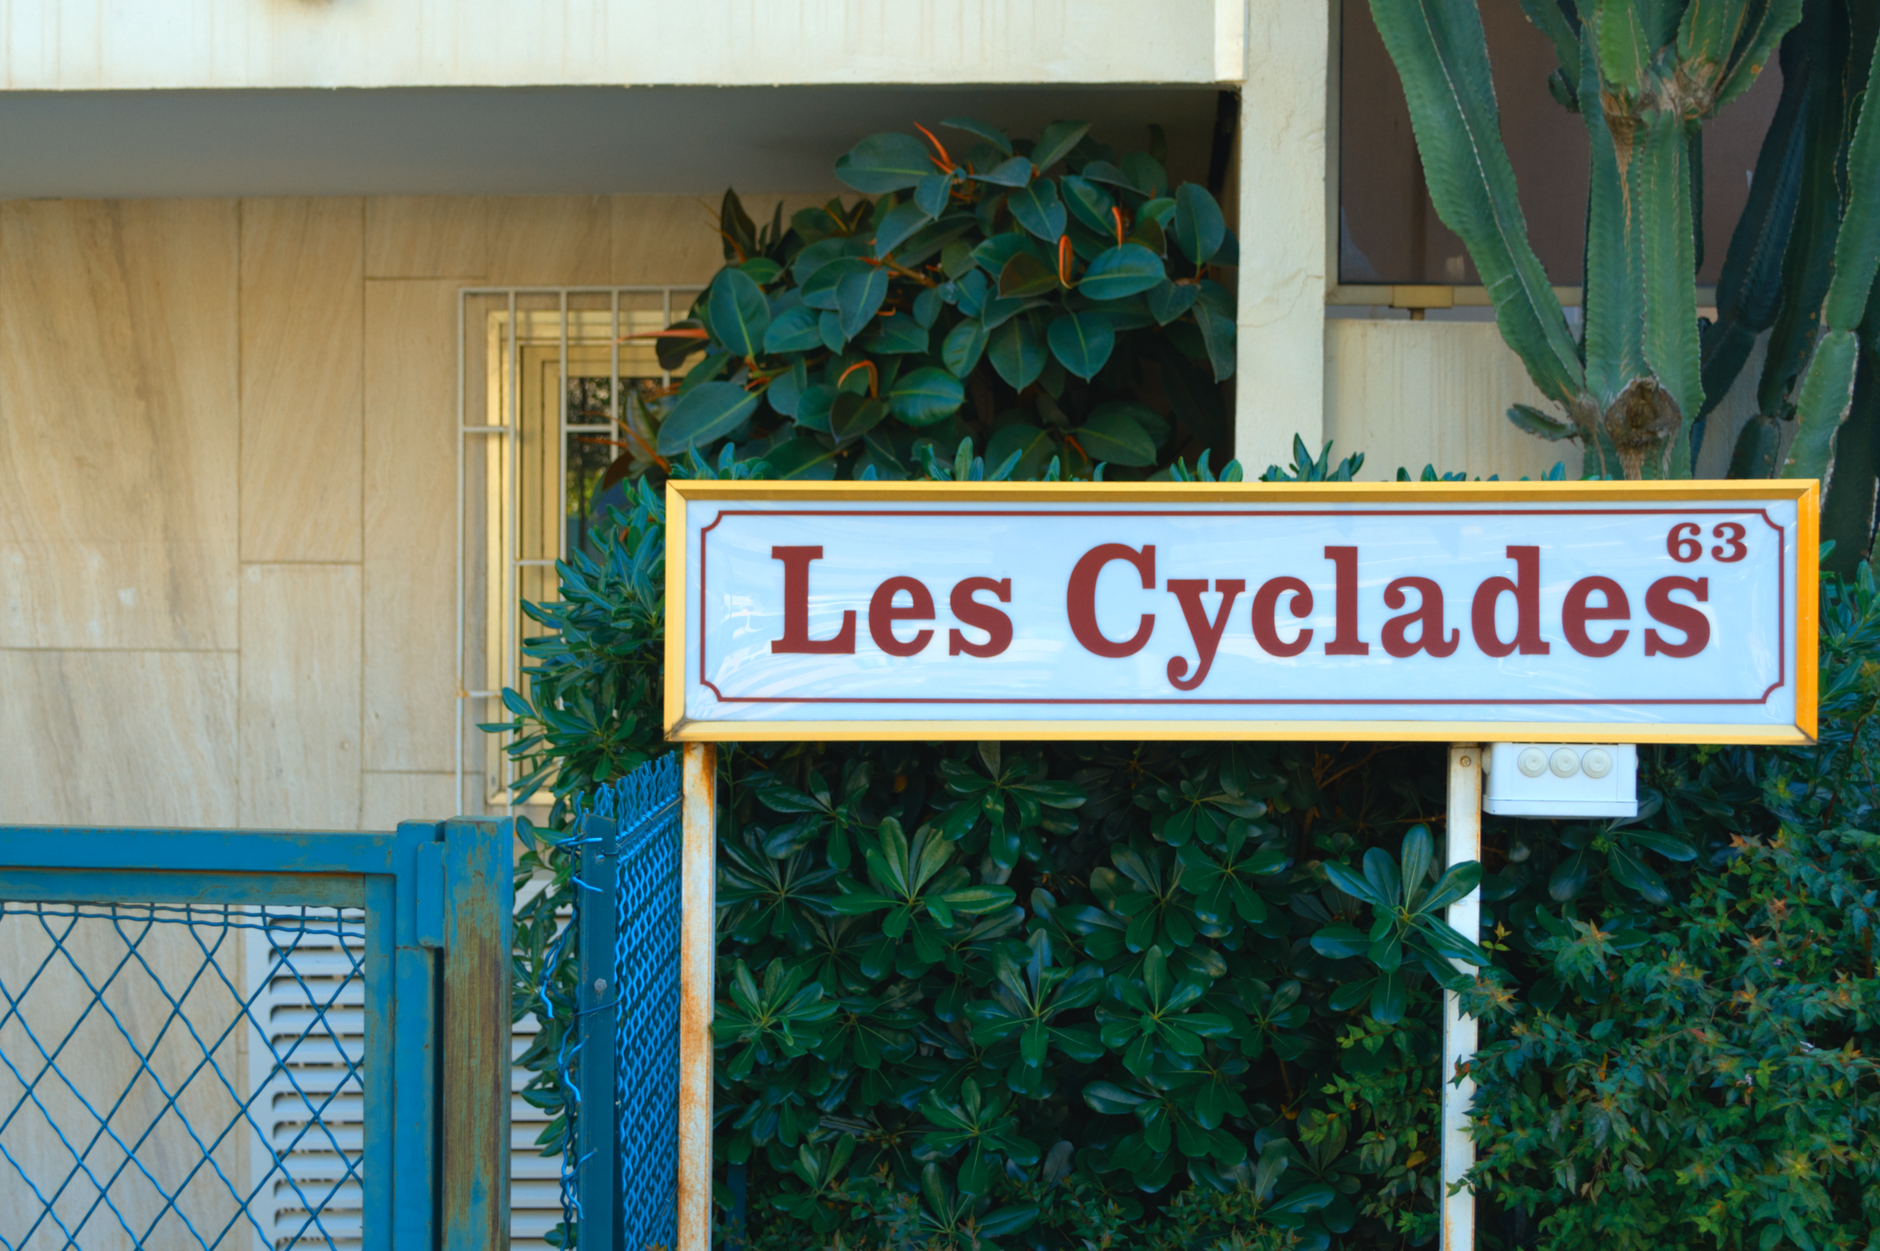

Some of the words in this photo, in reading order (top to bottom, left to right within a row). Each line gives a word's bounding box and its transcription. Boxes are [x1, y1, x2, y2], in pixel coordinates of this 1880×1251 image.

[1666, 522, 1748, 563] 63
[771, 545, 1013, 658] Les
[1066, 543, 1710, 691] Cyclades
